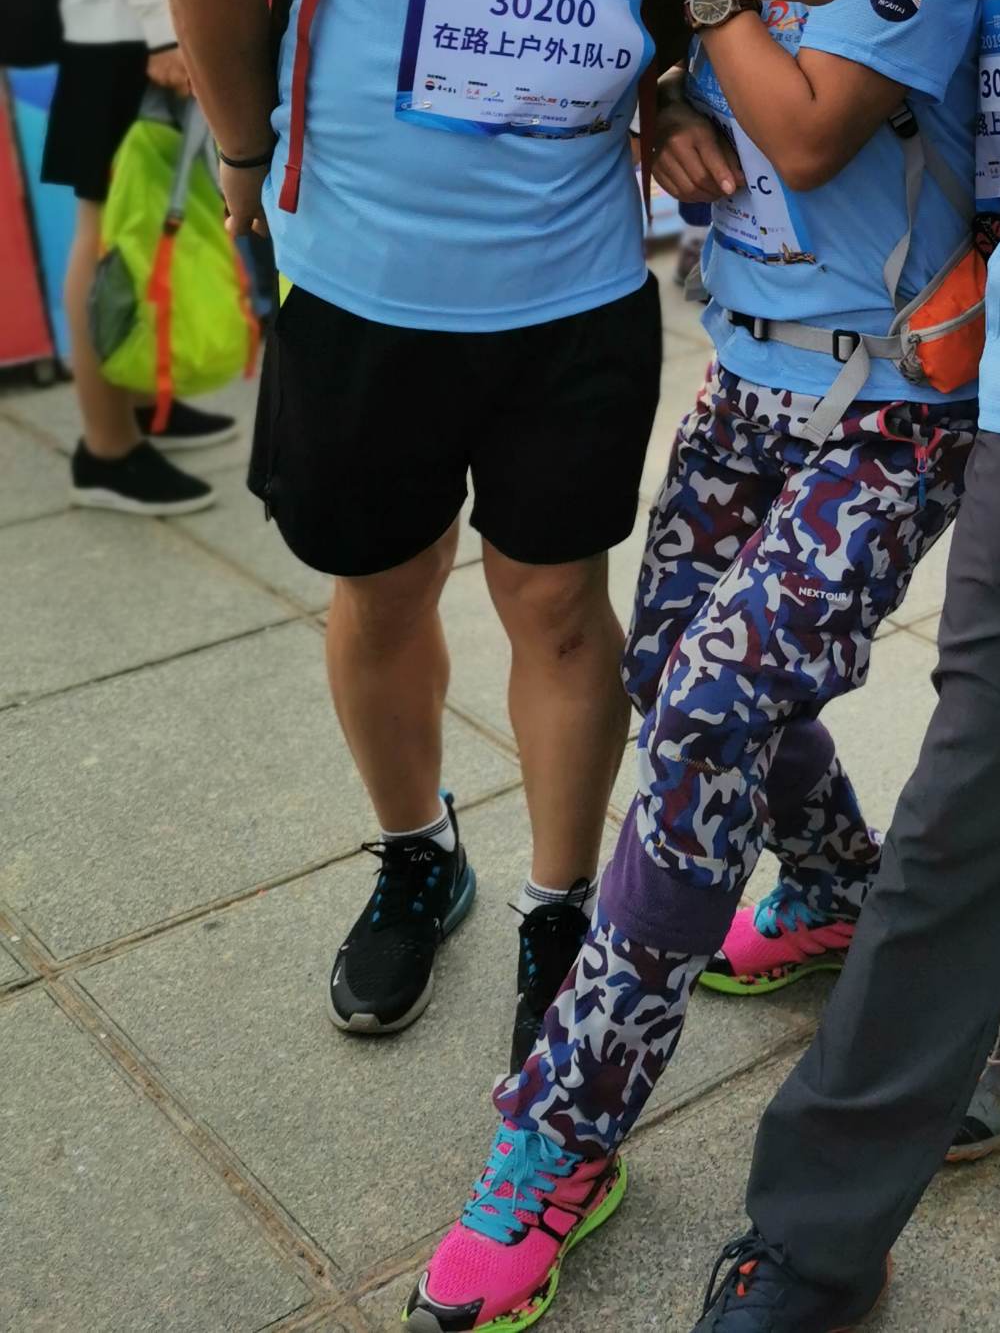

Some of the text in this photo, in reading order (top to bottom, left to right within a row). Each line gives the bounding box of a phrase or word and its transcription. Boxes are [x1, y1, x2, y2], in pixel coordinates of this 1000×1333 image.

[432, 22, 632, 71] 在路上户外1队-D
[798, 586, 848, 602] NEXTOUR
